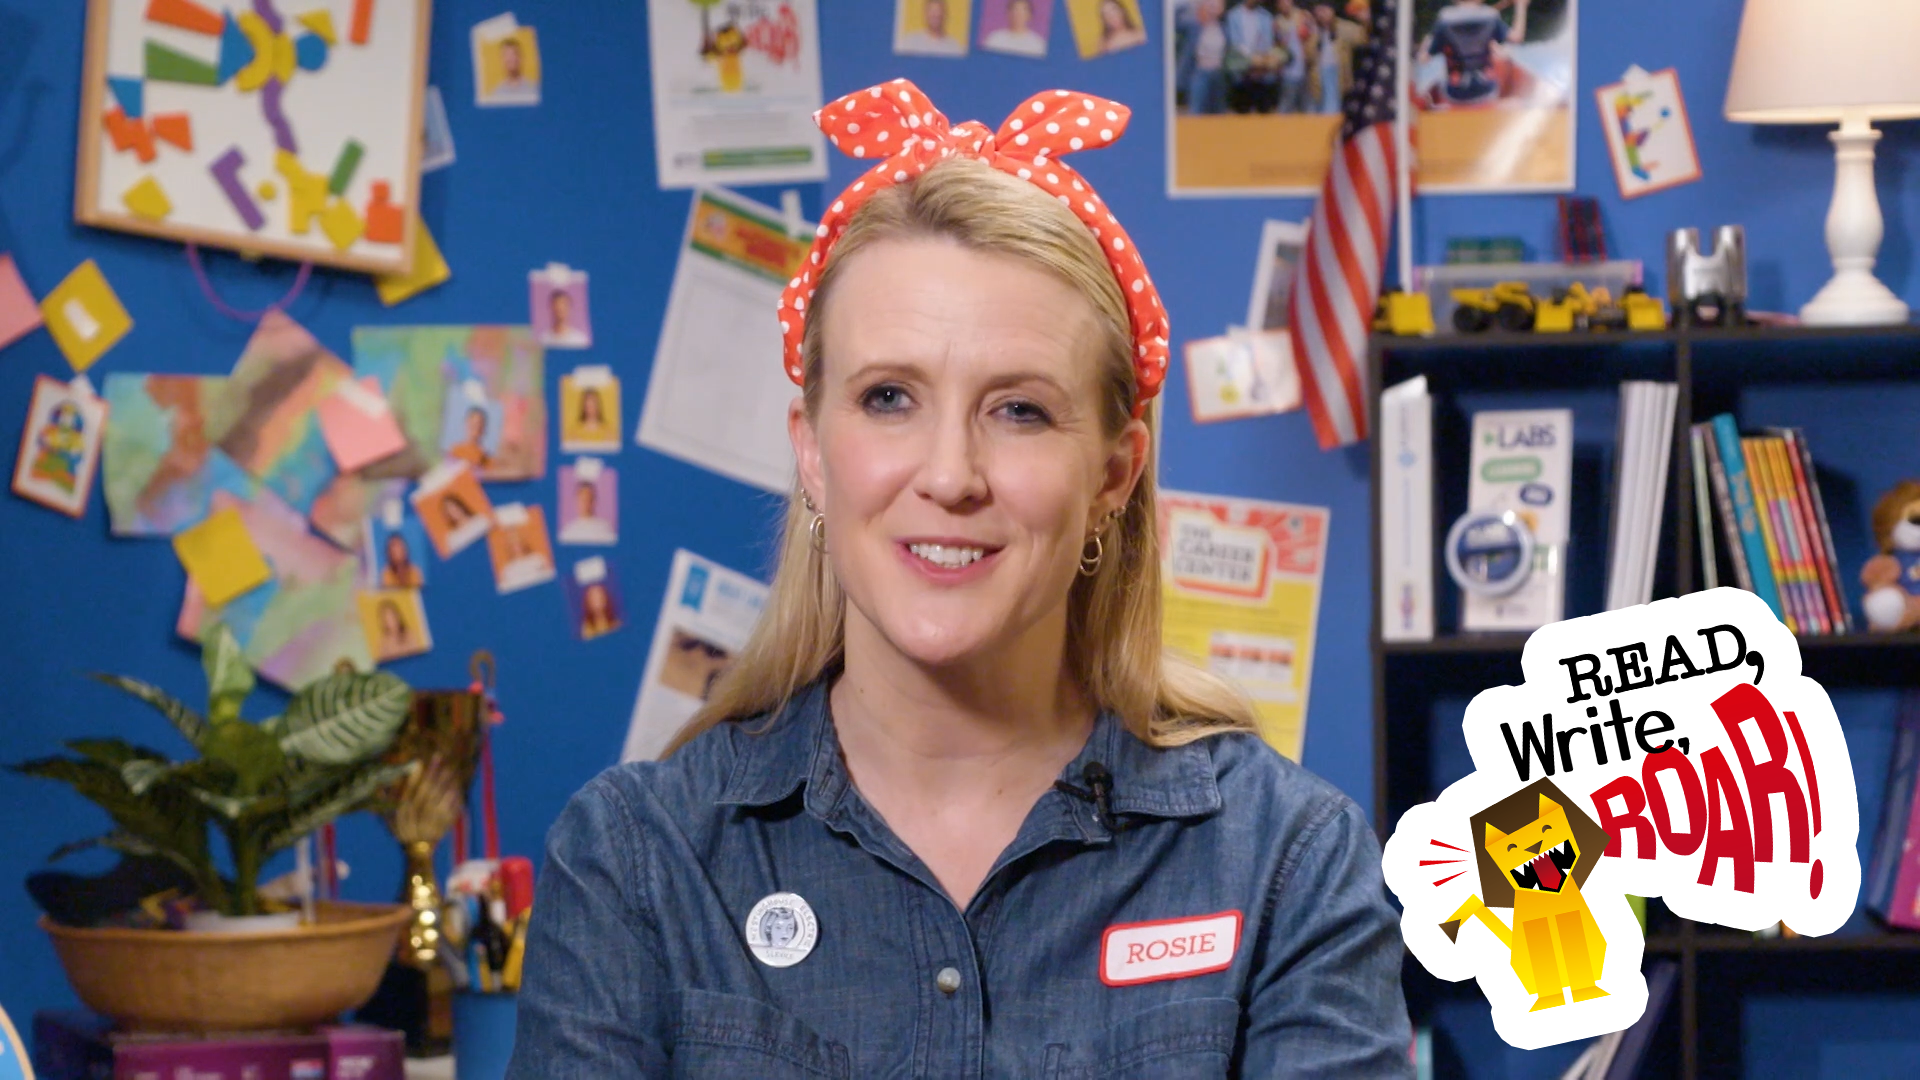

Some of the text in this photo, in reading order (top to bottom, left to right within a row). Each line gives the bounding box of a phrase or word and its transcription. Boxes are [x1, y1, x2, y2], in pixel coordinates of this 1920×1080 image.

[1497, 424, 1557, 449] LABS
[1178, 536, 1255, 563] CAREER
[1174, 555, 1252, 582] CENTER
[1126, 932, 1217, 965] ROSIE
